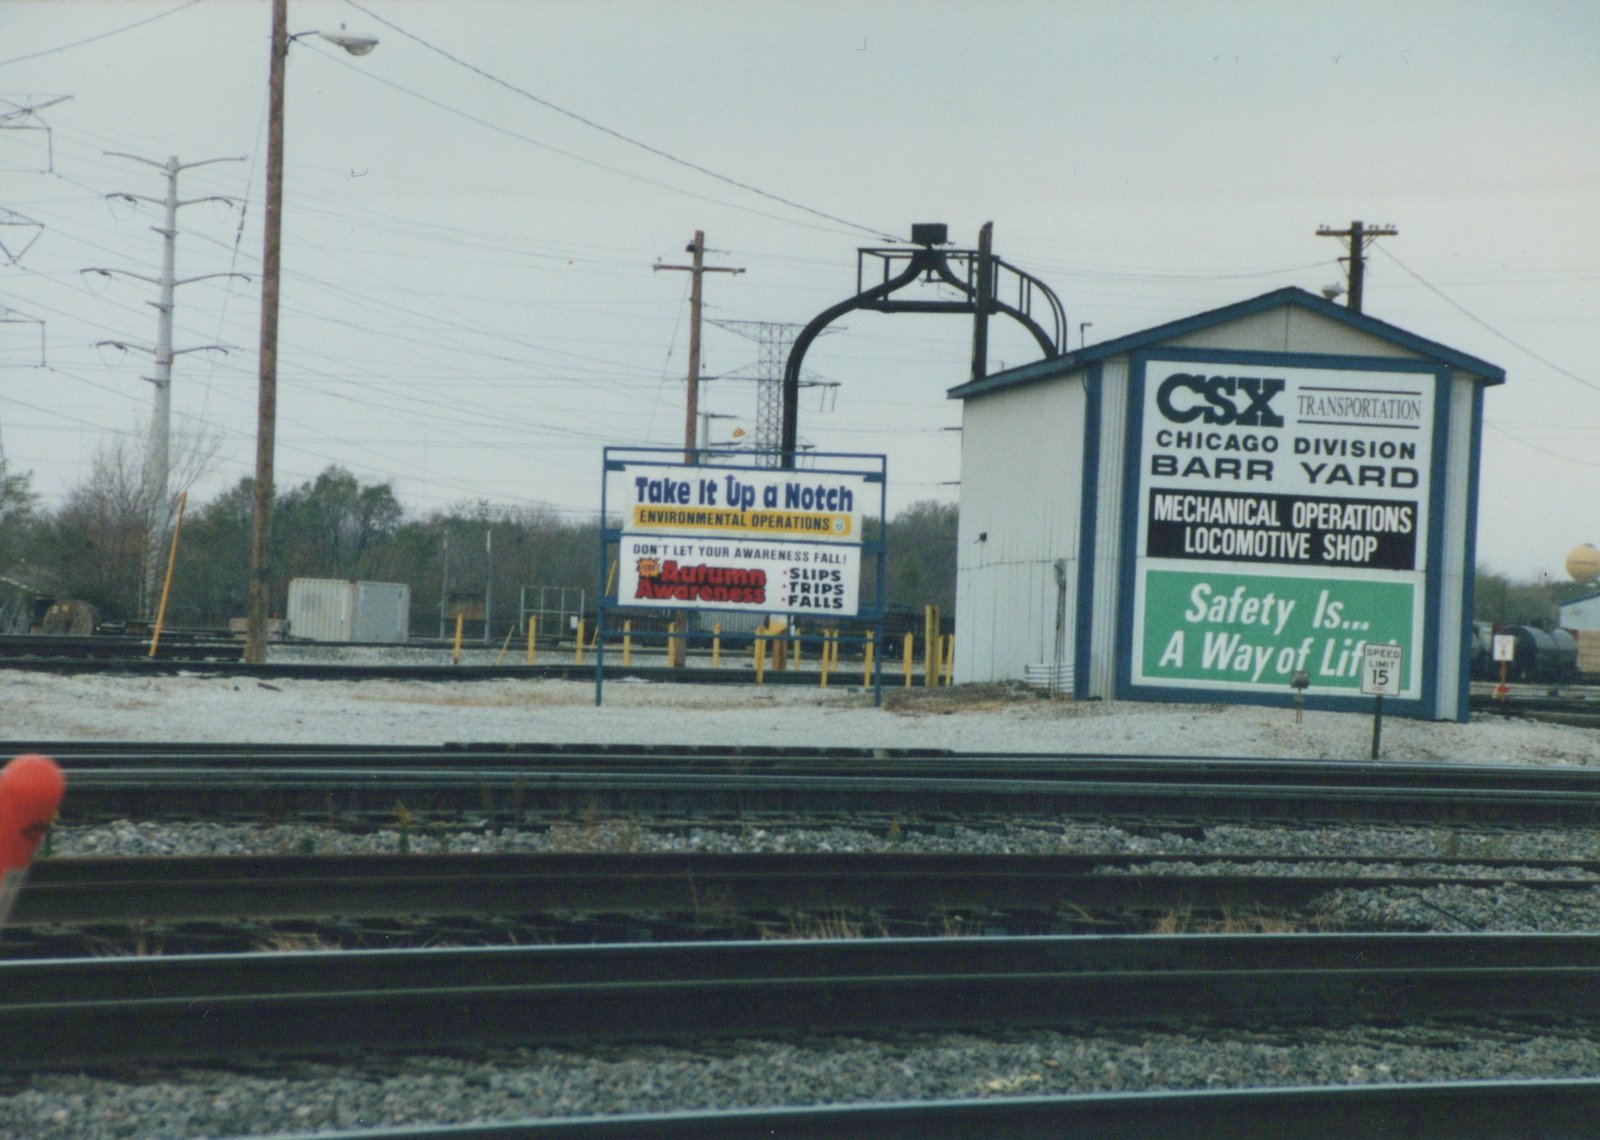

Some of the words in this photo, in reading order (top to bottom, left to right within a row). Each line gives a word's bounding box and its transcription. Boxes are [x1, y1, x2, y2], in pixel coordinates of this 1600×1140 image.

[1156, 373, 1285, 428] CSX
[1297, 395, 1421, 420] TRANSPORTATION
[1157, 430, 1279, 452] CHICAGO
[1295, 438, 1415, 459] DIVISION
[1151, 455, 1274, 480] BARR
[1300, 462, 1419, 488] YARD
[636, 477, 690, 504] Take
[699, 479, 717, 505] It
[725, 475, 755, 511] Up
[763, 486, 777, 507] a
[785, 483, 853, 511] Notch
[640, 511, 746, 527] ENVIRONMENTAL
[752, 514, 830, 531] OPERATIONS
[1154, 494, 1280, 523] MECHANICAL
[1292, 502, 1412, 533] OPERATIONS
[633, 545, 669, 555] DON'T
[674, 546, 693, 556] LET
[699, 547, 729, 557] YOUR
[734, 548, 810, 562] AWARENESS
[814, 552, 847, 564] FALL!
[1185, 527, 1310, 558] LOCOMOTIVE
[1323, 535, 1378, 561] SHOP
[661, 560, 766, 586] Autumn
[789, 568, 841, 581] SLIPS
[635, 578, 766, 603] Awareness
[789, 582, 844, 595] TRIPS
[788, 596, 843, 609] FALLS
[1185, 583, 1295, 635] Safety
[1313, 590, 1370, 630] Is...
[1159, 630, 1184, 668] A
[1202, 632, 1274, 681] Way
[1276, 637, 1314, 674] of
[1367, 648, 1399, 658] SPEED
[1369, 660, 1395, 669] LIMIT
[1373, 669, 1388, 685] 15
